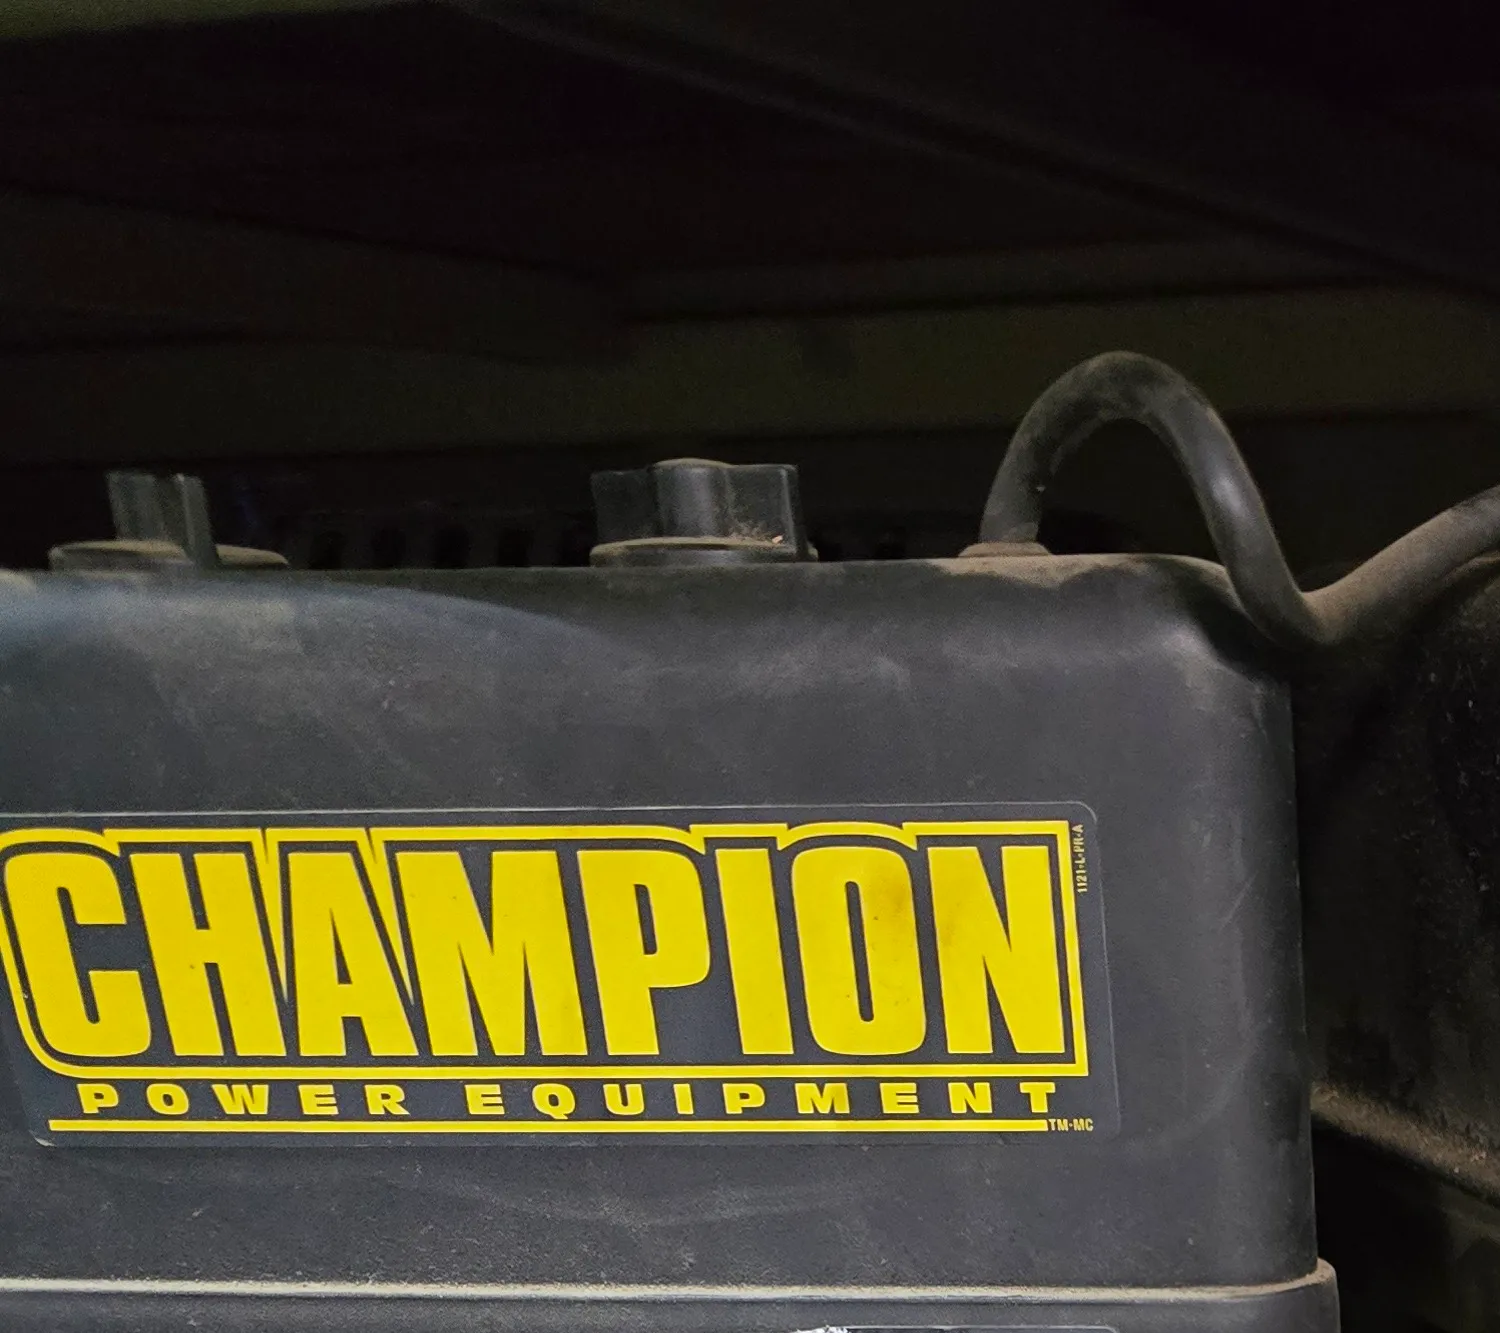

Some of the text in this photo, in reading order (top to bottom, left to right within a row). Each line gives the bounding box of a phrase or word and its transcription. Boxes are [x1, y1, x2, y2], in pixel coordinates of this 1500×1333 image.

[4, 846, 1066, 1057] CHAMPION
[77, 1082, 1056, 1119] POWER EQUIPMENT
